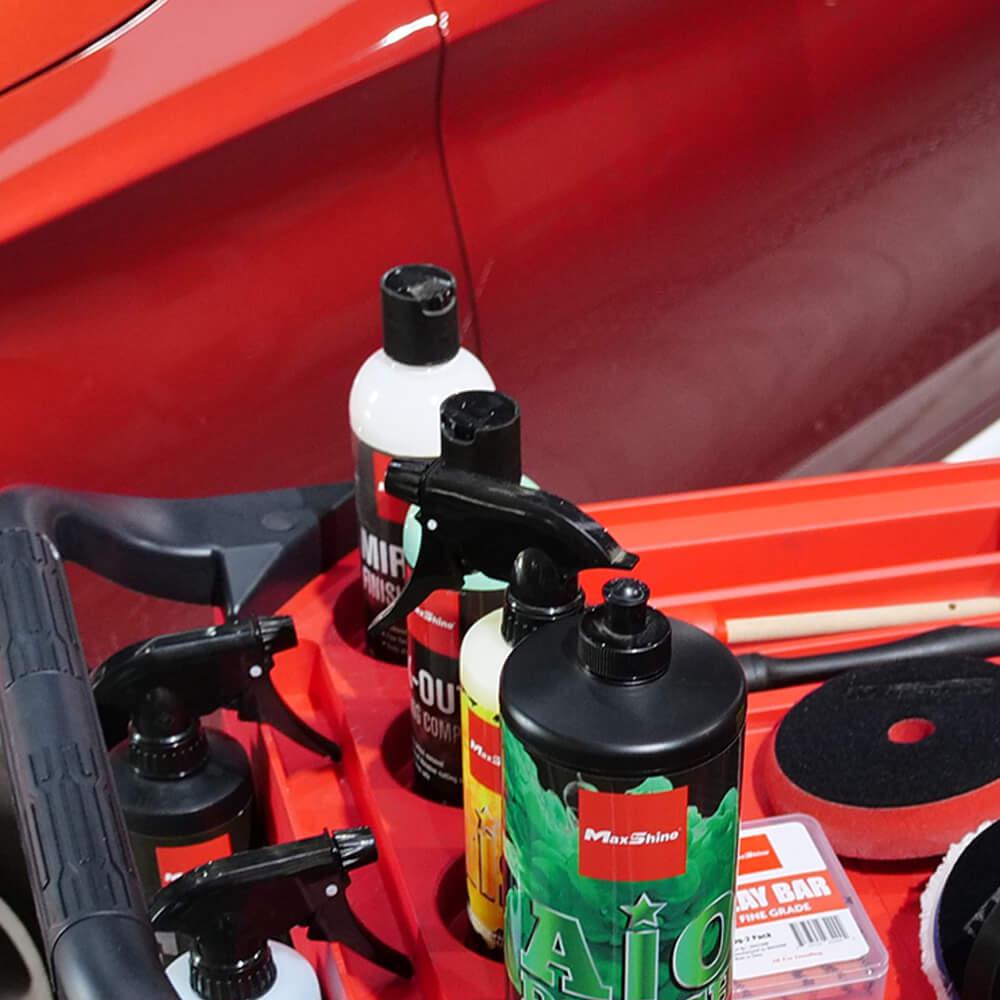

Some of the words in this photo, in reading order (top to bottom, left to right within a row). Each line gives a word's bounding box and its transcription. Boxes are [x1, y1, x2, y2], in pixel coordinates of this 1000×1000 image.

[361, 526, 406, 578] MIR
[470, 739, 502, 768] MaxS
[583, 828, 680, 845] MaxShine
[735, 886, 769, 913] AY
[771, 875, 832, 904] BAR
[738, 910, 768, 923] FINE
[768, 901, 813, 918] GRADE
